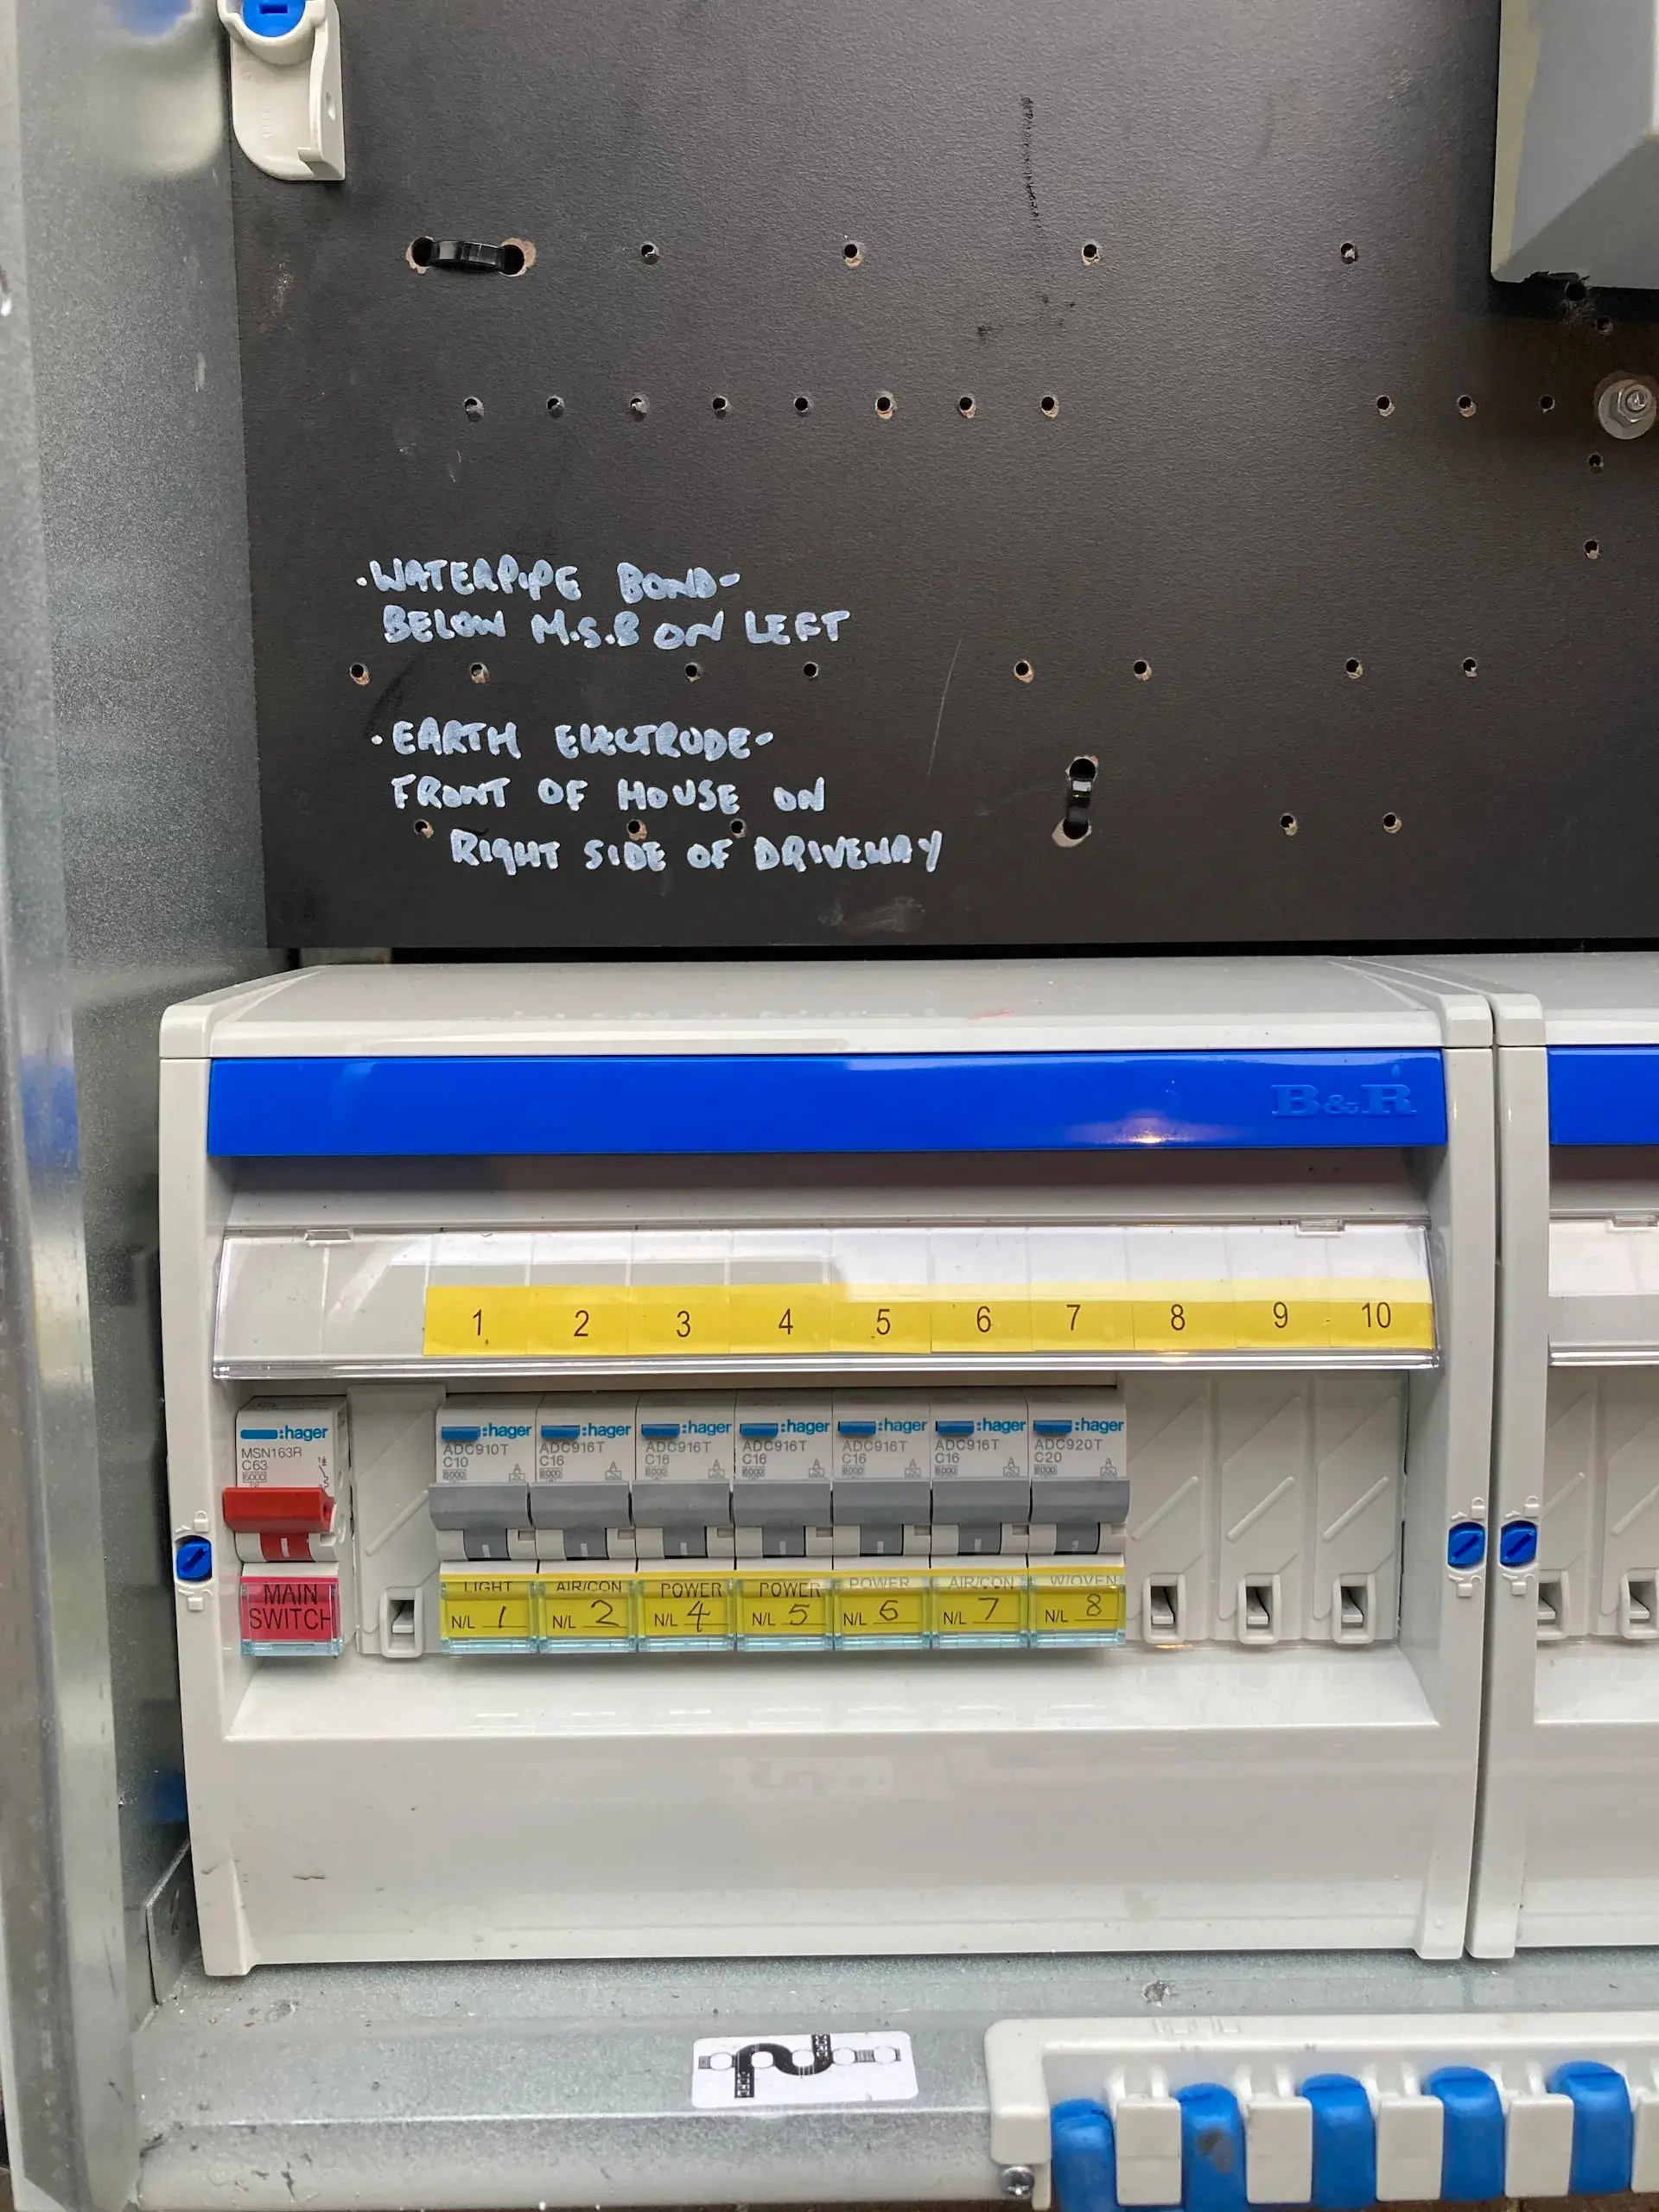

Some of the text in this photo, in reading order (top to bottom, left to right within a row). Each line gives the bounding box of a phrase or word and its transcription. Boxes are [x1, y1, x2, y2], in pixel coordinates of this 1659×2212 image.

[383, 605, 505, 643] BELOW
[653, 610, 724, 649] ON
[745, 610, 850, 645] LEFT
[392, 716, 521, 759] EARTH
[391, 773, 824, 815] FRONT OF HOUSE ON
[583, 839, 666, 873] SIDE
[687, 838, 734, 869] OF
[753, 830, 943, 873] DRIVEWAY
[1270, 1084, 1417, 1117] B&R
[472, 1308, 484, 1337] 1
[574, 1310, 588, 1338] 2
[676, 1311, 691, 1338] 3
[778, 1308, 793, 1336] 4
[876, 1308, 891, 1335] 5
[976, 1306, 992, 1333] 6
[1066, 1304, 1081, 1332] 7
[1170, 1303, 1185, 1332] 8
[1273, 1301, 1288, 1329] 9
[1361, 1301, 1391, 1329] 10
[241, 1446, 302, 1459] MSN163R
[442, 1444, 509, 1455] ADC910T
[539, 1441, 605, 1453] ADC916T
[645, 1441, 711, 1453] ADC916T
[742, 1440, 807, 1452] ADC916T
[842, 1440, 907, 1452] ADC916T
[935, 1439, 1000, 1451] ADC916T
[1034, 1439, 1103, 1451] ADC920T
[242, 1459, 268, 1471] C63
[442, 1457, 468, 1468] C10
[539, 1455, 564, 1466] C16
[645, 1453, 671, 1465] C16
[742, 1453, 767, 1465] C16
[842, 1452, 867, 1465] C16
[935, 1452, 960, 1464] C16
[1034, 1452, 1062, 1464] C20
[464, 1581, 512, 1592] LIGHT
[556, 1580, 621, 1592] AIR/CON
[661, 1583, 722, 1598] POWER
[760, 1581, 821, 1598] POWER
[849, 1577, 910, 1588] POWER
[950, 1576, 1014, 1589] AIR/CON
[264, 1584, 318, 1605] MAIN
[552, 1599, 620, 1629] N/L 2
[654, 1600, 710, 1632] N/L 4
[753, 1604, 810, 1626] N/L 5
[843, 1599, 899, 1626] N/L 6
[943, 1598, 999, 1625] N/L 7
[1045, 1593, 1102, 1623] N/L 8
[249, 1608, 331, 1630] SWITCH
[451, 1615, 475, 1629] N/L
